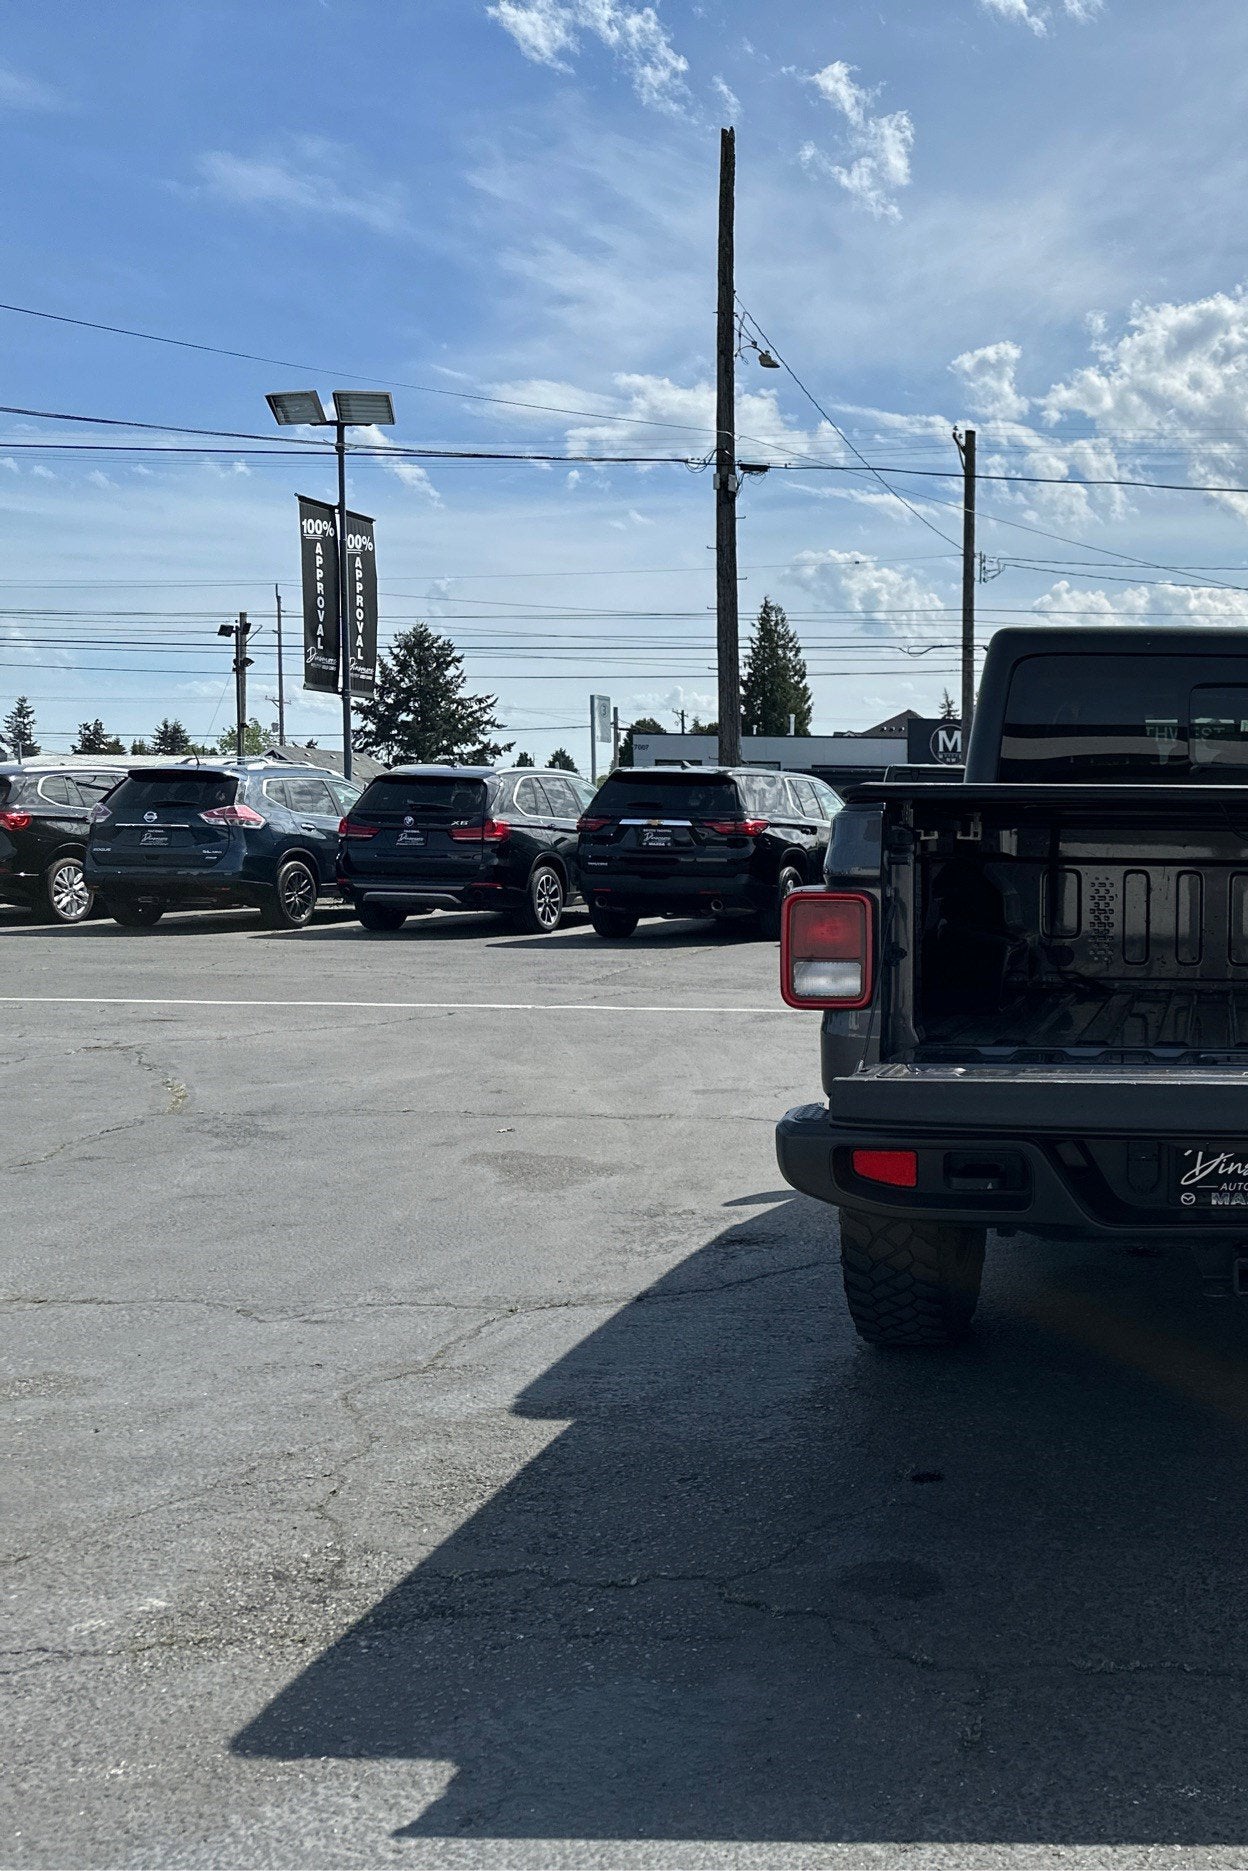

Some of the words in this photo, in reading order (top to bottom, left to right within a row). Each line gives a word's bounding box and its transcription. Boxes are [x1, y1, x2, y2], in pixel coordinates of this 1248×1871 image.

[302, 519, 335, 536] 100%
[347, 534, 373, 551] 00%
[314, 542, 325, 650] APPROVAL
[354, 556, 365, 660] APPROVAL
[938, 730, 962, 752] M
